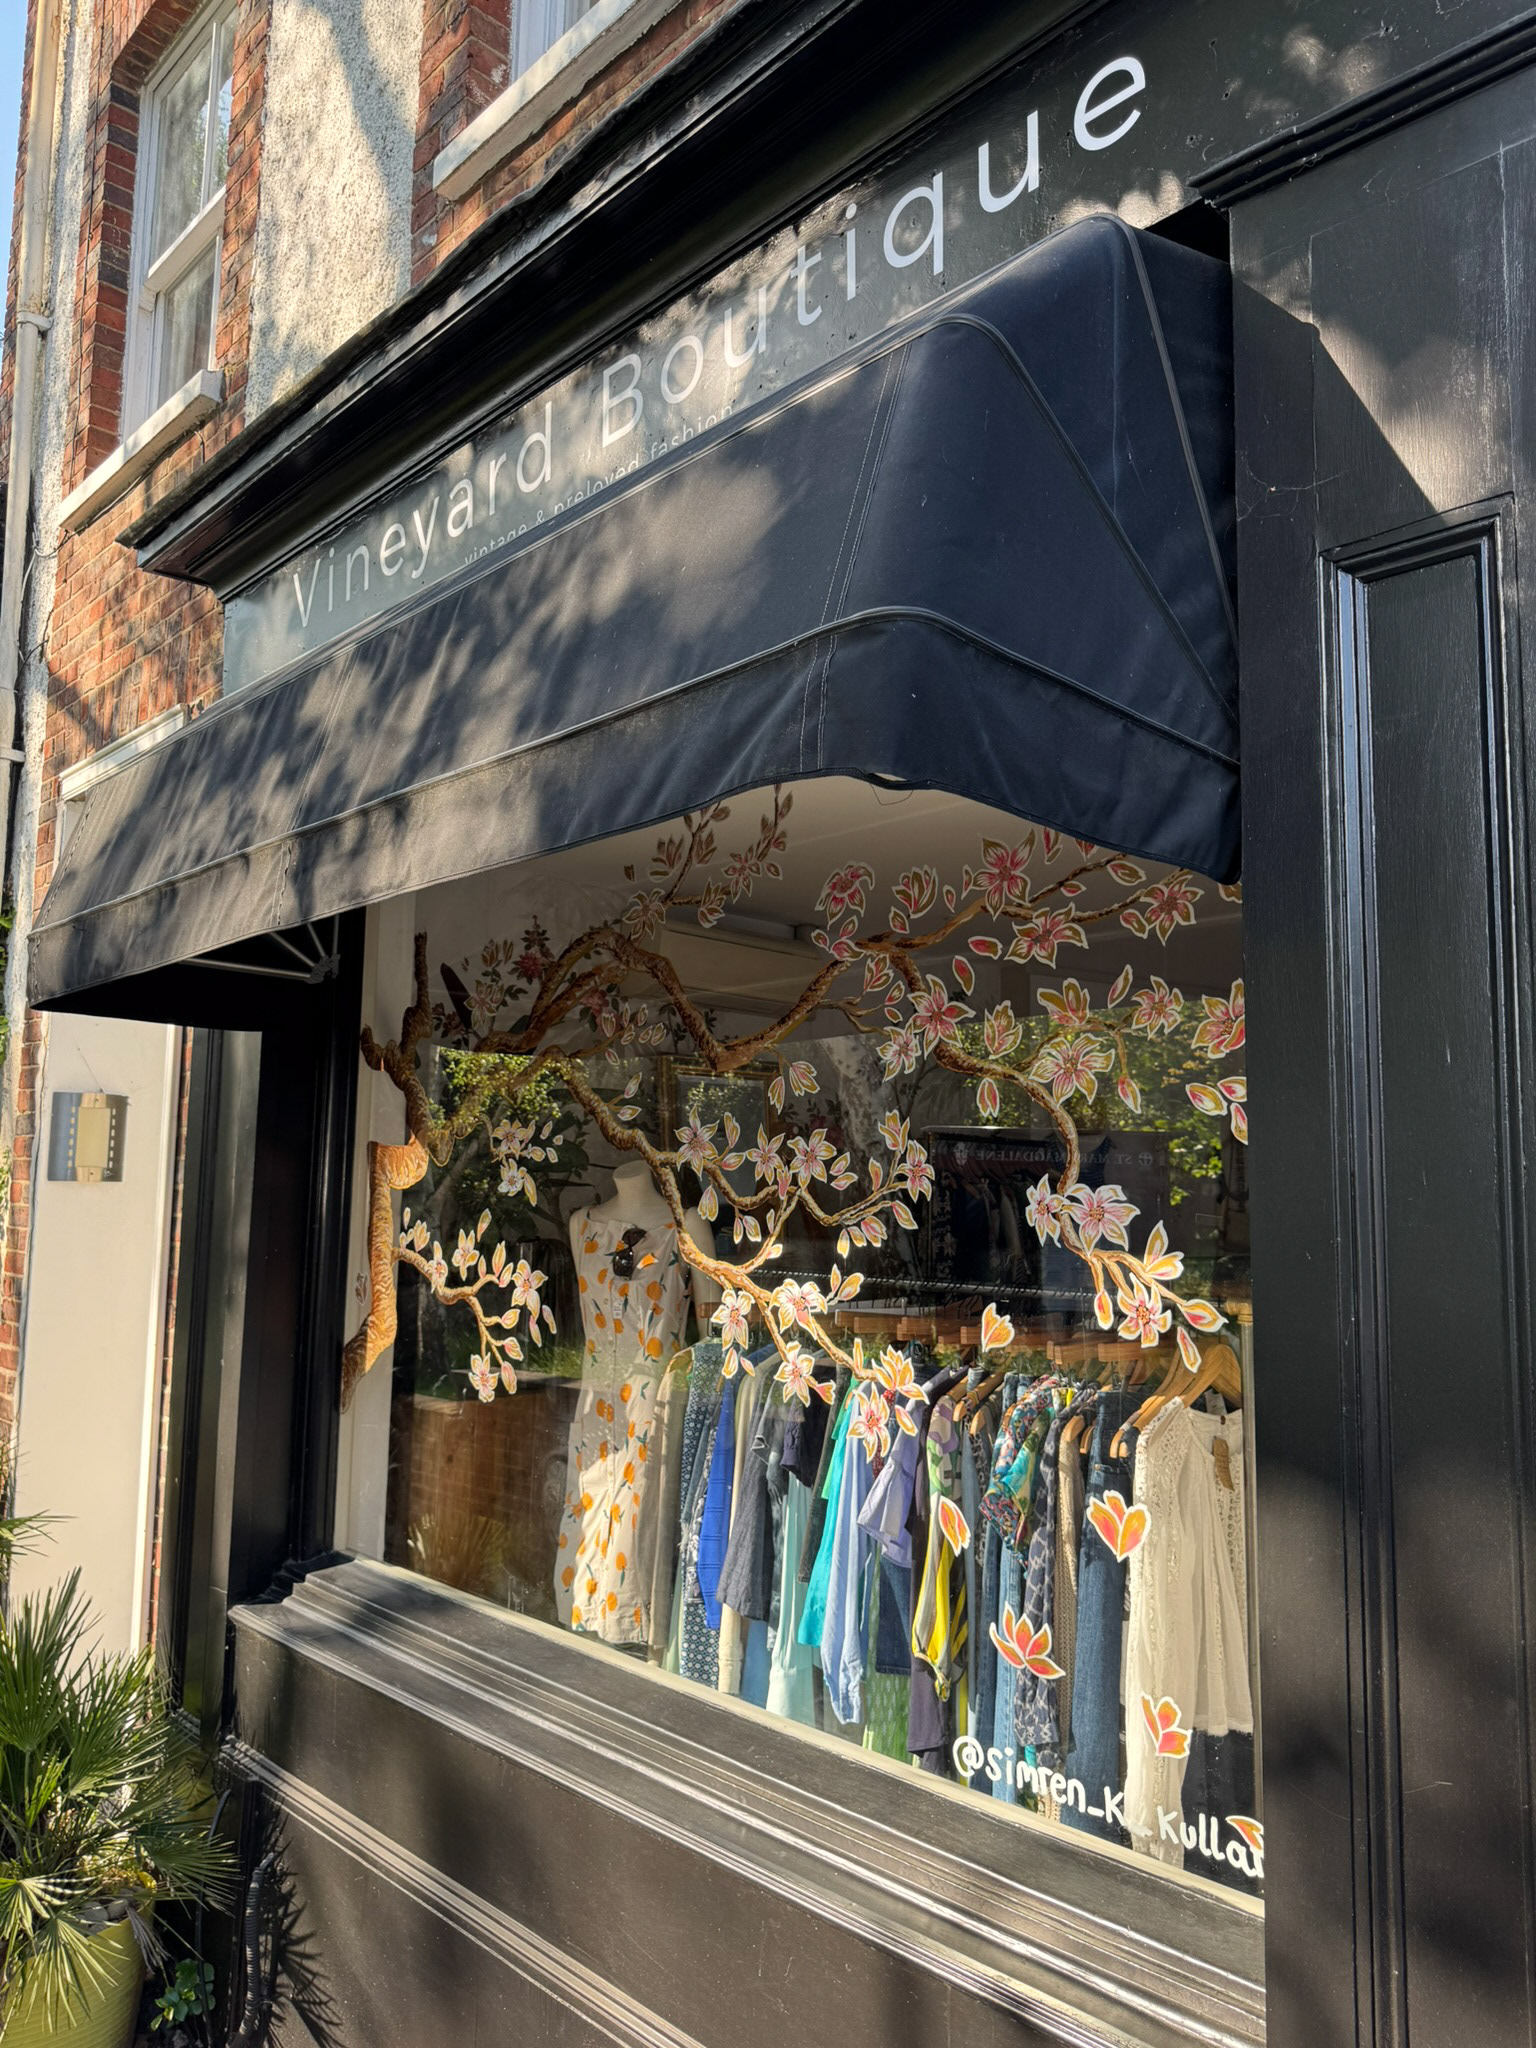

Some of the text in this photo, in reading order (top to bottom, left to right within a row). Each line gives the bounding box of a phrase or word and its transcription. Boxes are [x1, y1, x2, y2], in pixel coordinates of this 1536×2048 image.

[293, 56, 1146, 628] Vineyard Boutique
[650, 405, 732, 459] fashion
